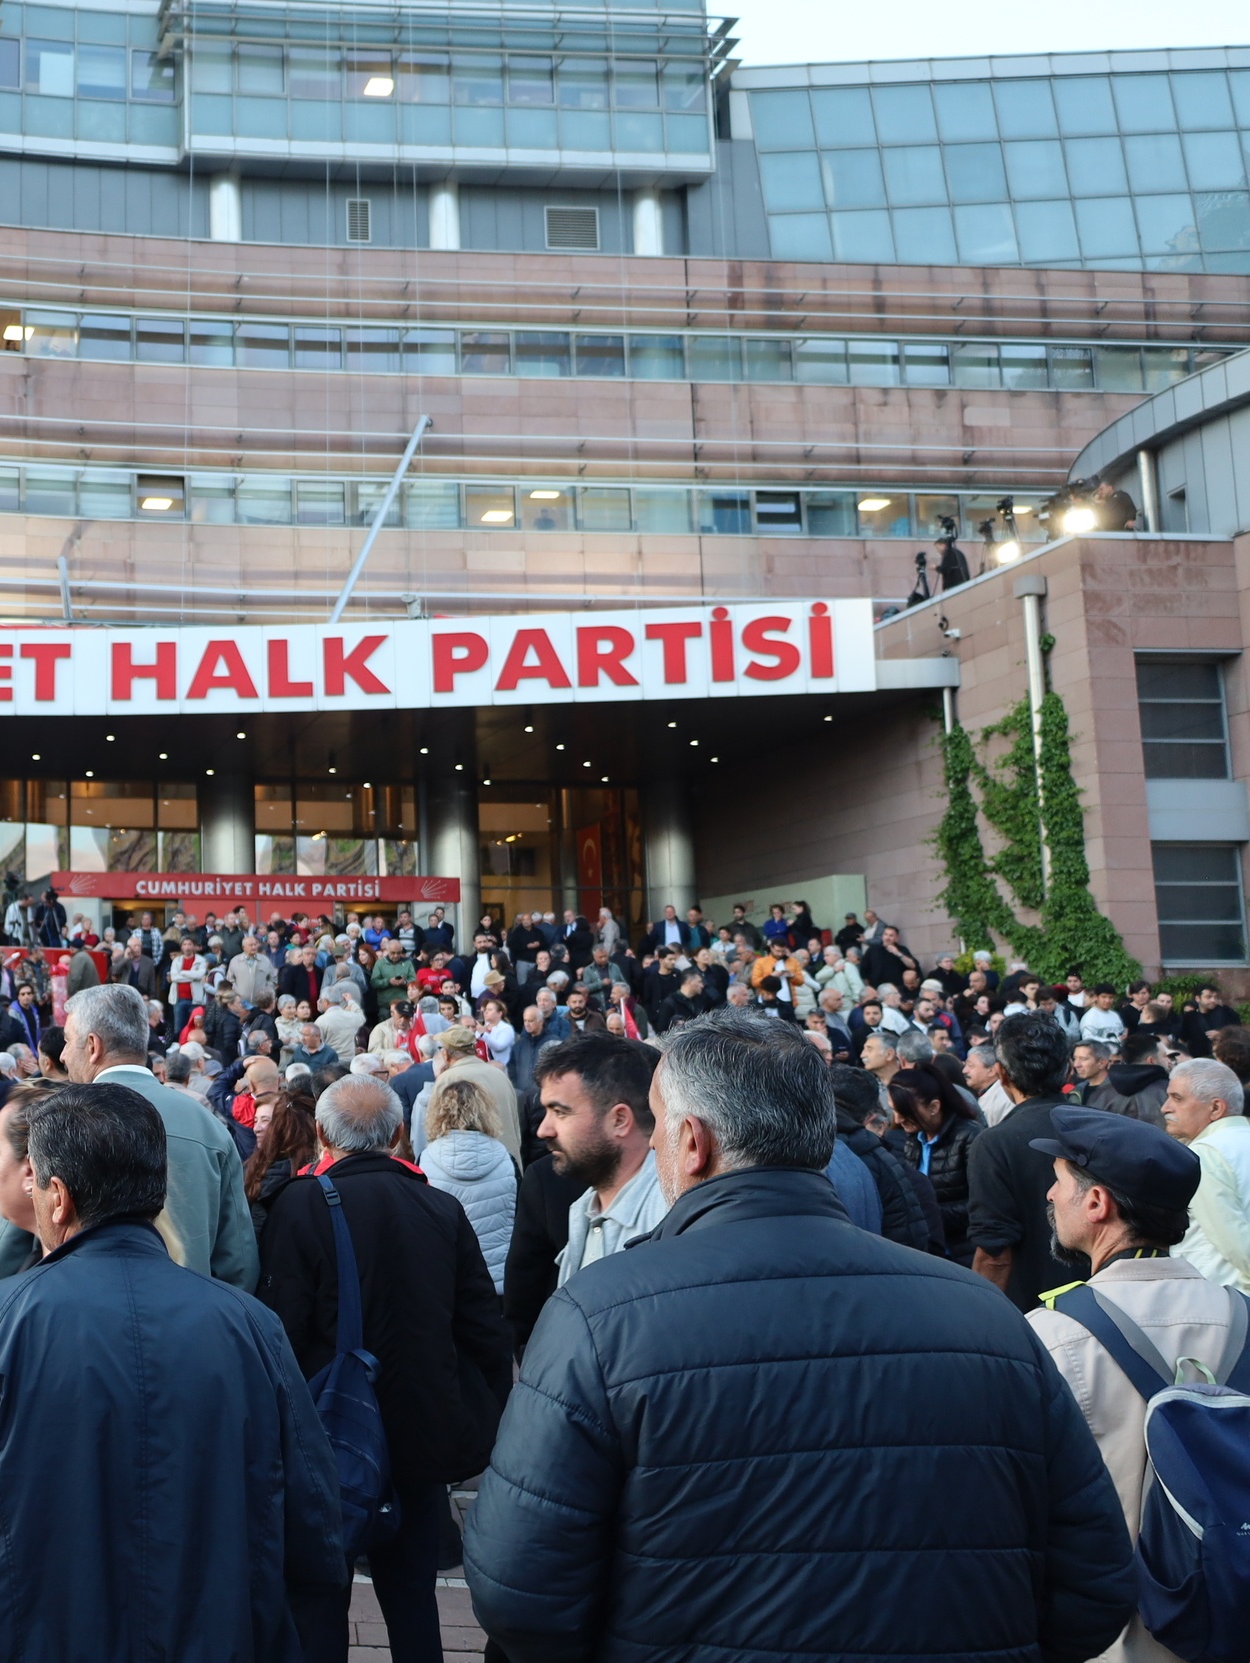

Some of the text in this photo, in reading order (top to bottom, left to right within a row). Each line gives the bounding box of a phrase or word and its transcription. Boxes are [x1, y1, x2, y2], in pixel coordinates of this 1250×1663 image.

[111, 635, 391, 700] HALK
[432, 602, 834, 692] PARTİSİ
[135, 877, 381, 897] CUMHURİYET HALK PARTİSİ
